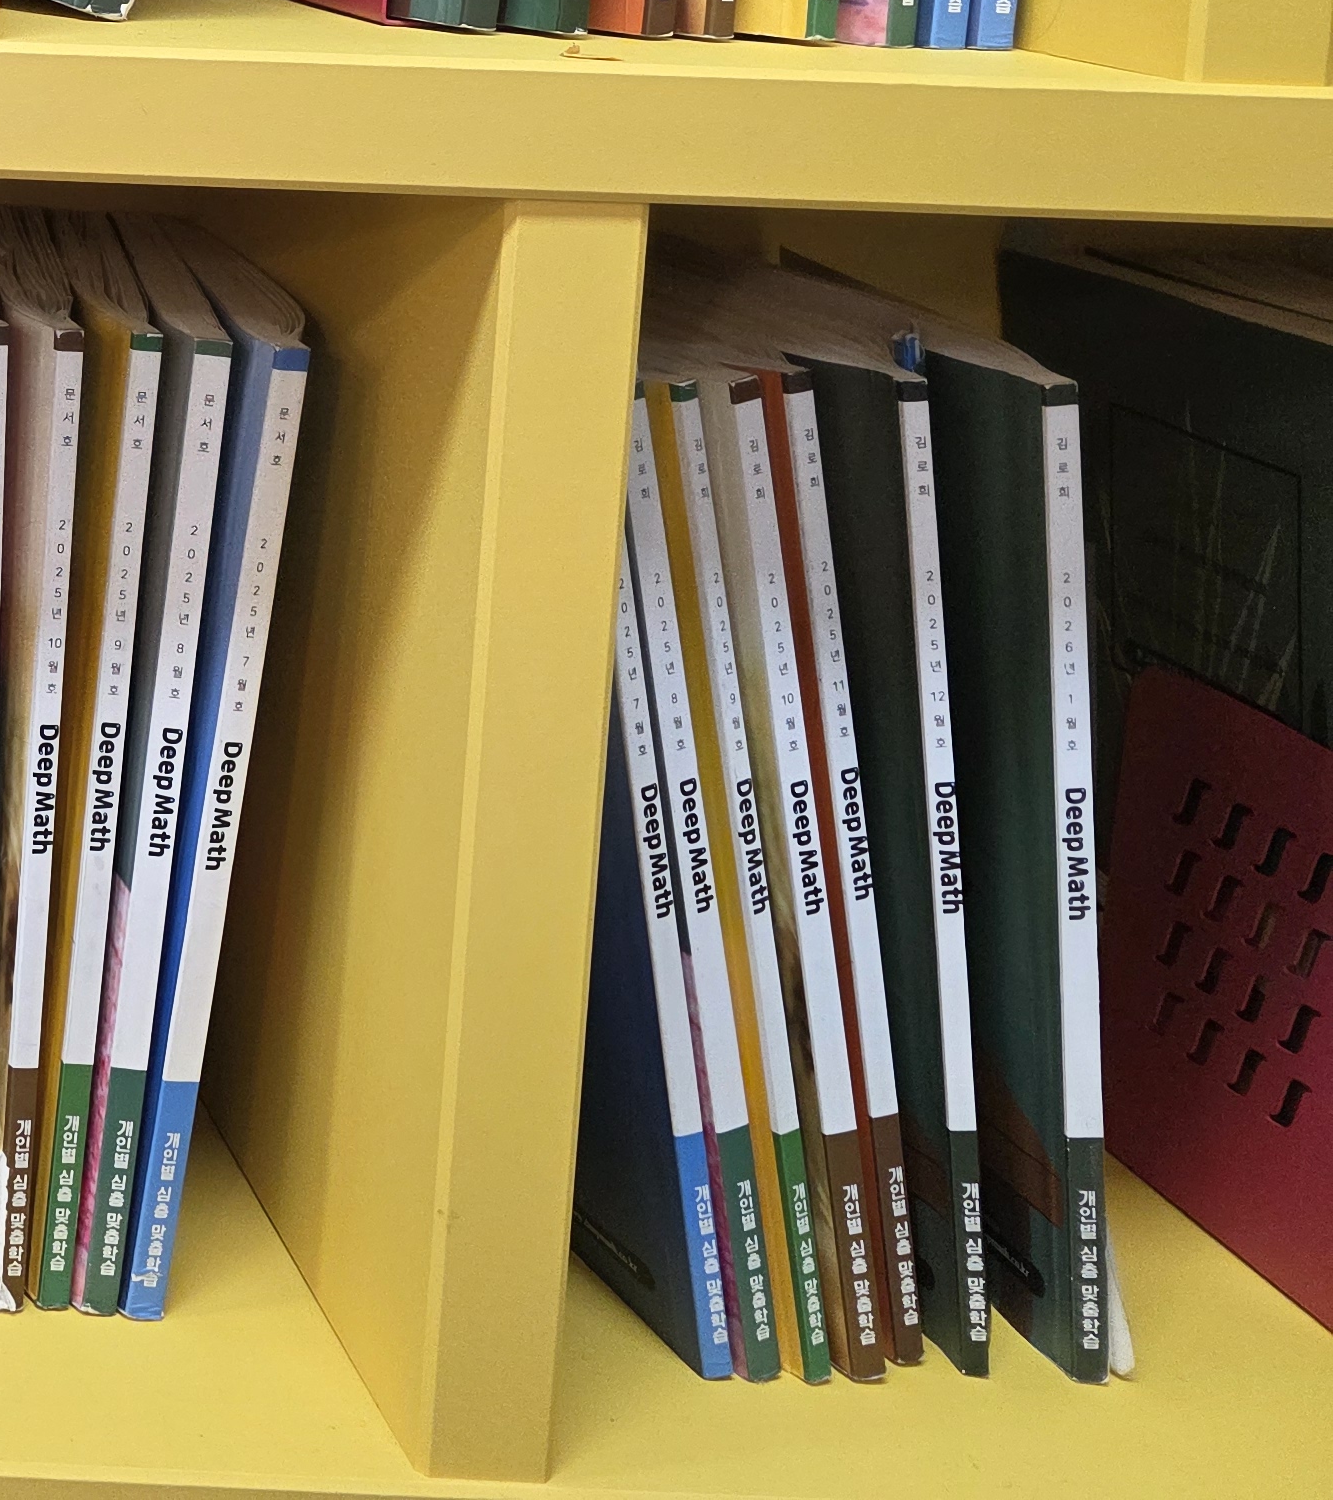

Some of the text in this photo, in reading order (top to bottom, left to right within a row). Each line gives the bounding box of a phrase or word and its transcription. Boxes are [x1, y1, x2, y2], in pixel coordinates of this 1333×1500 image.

[197, 393, 216, 455] 문서호
[99, 1119, 135, 1278] 개인별 심층 맞춤학습
[842, 1183, 877, 1347] 개인별 심층 맞춤학습
[1078, 1189, 1102, 1351] 개인별 심층 맞춤학습
